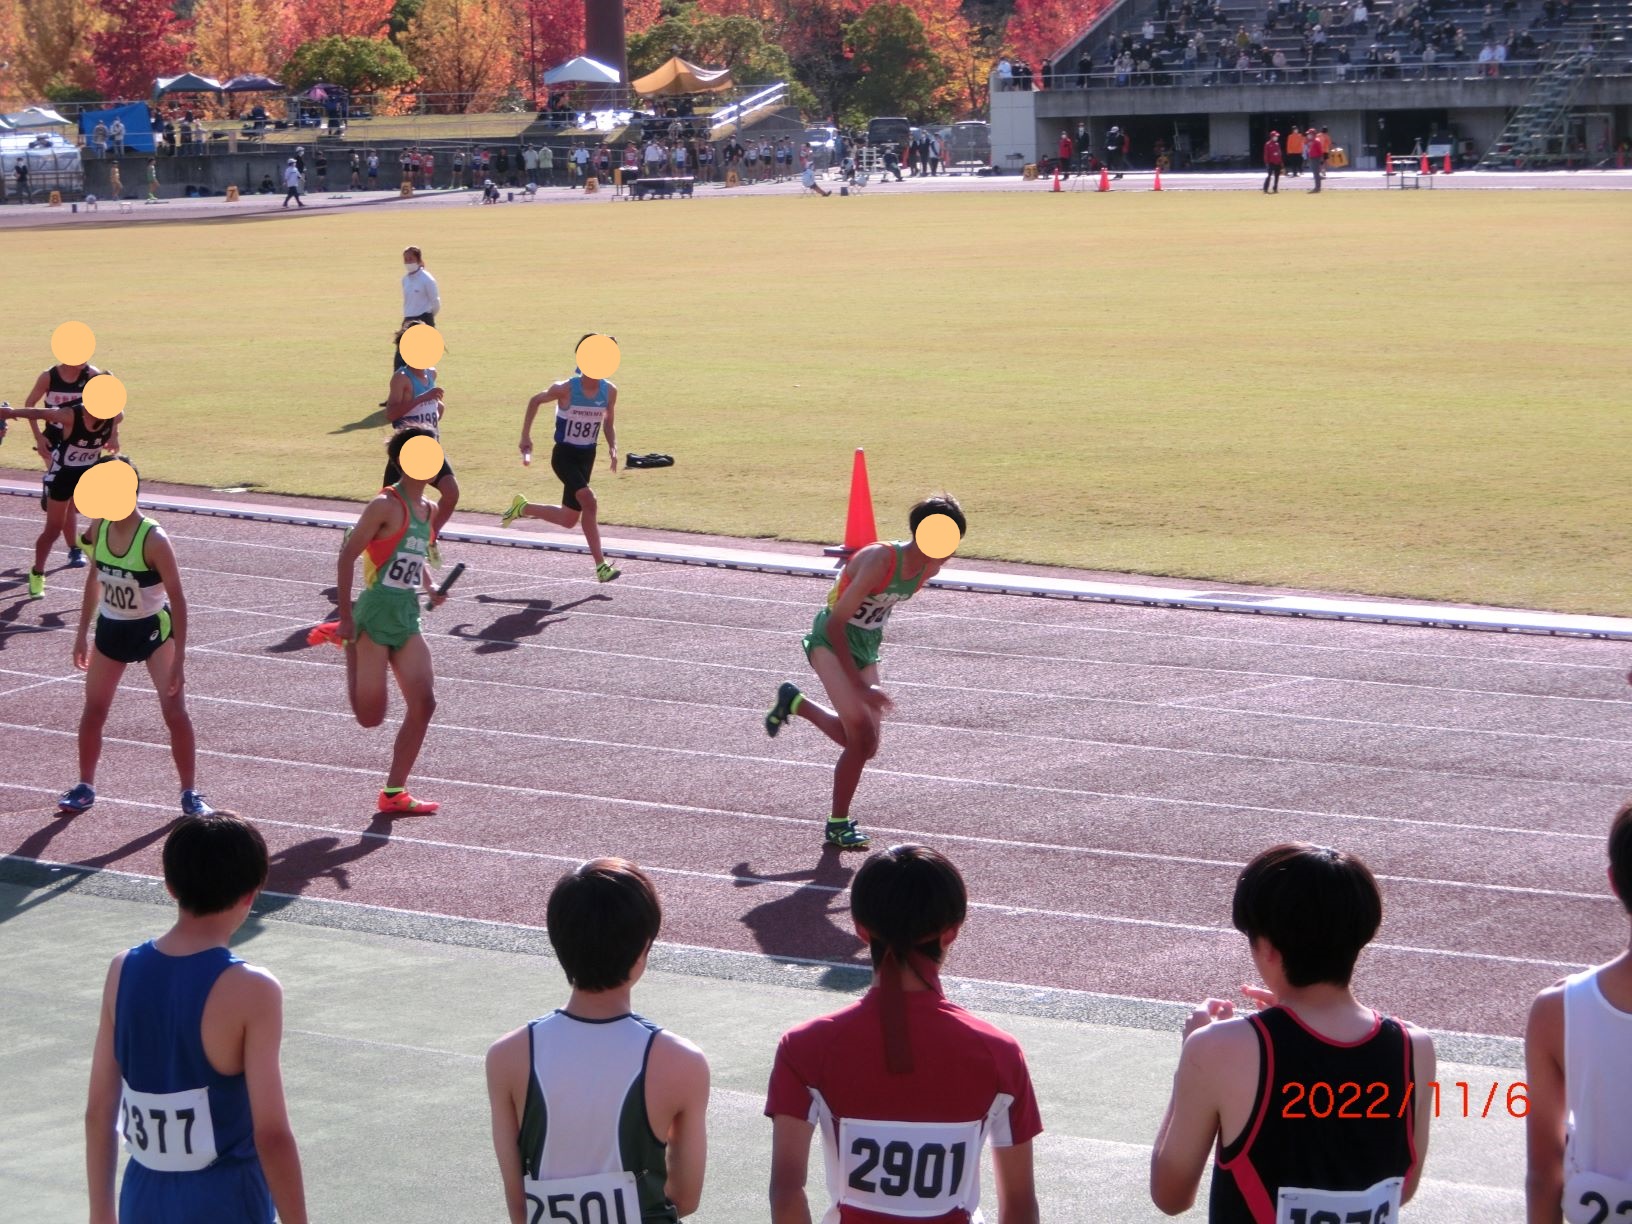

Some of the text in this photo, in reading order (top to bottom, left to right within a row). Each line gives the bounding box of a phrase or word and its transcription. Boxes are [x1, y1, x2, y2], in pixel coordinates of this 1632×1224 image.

[227, 188, 236, 199] 7
[567, 420, 601, 438] 1987
[101, 581, 138, 609] 2202
[122, 1097, 195, 1154] 2377
[848, 1137, 967, 1198] 2901
